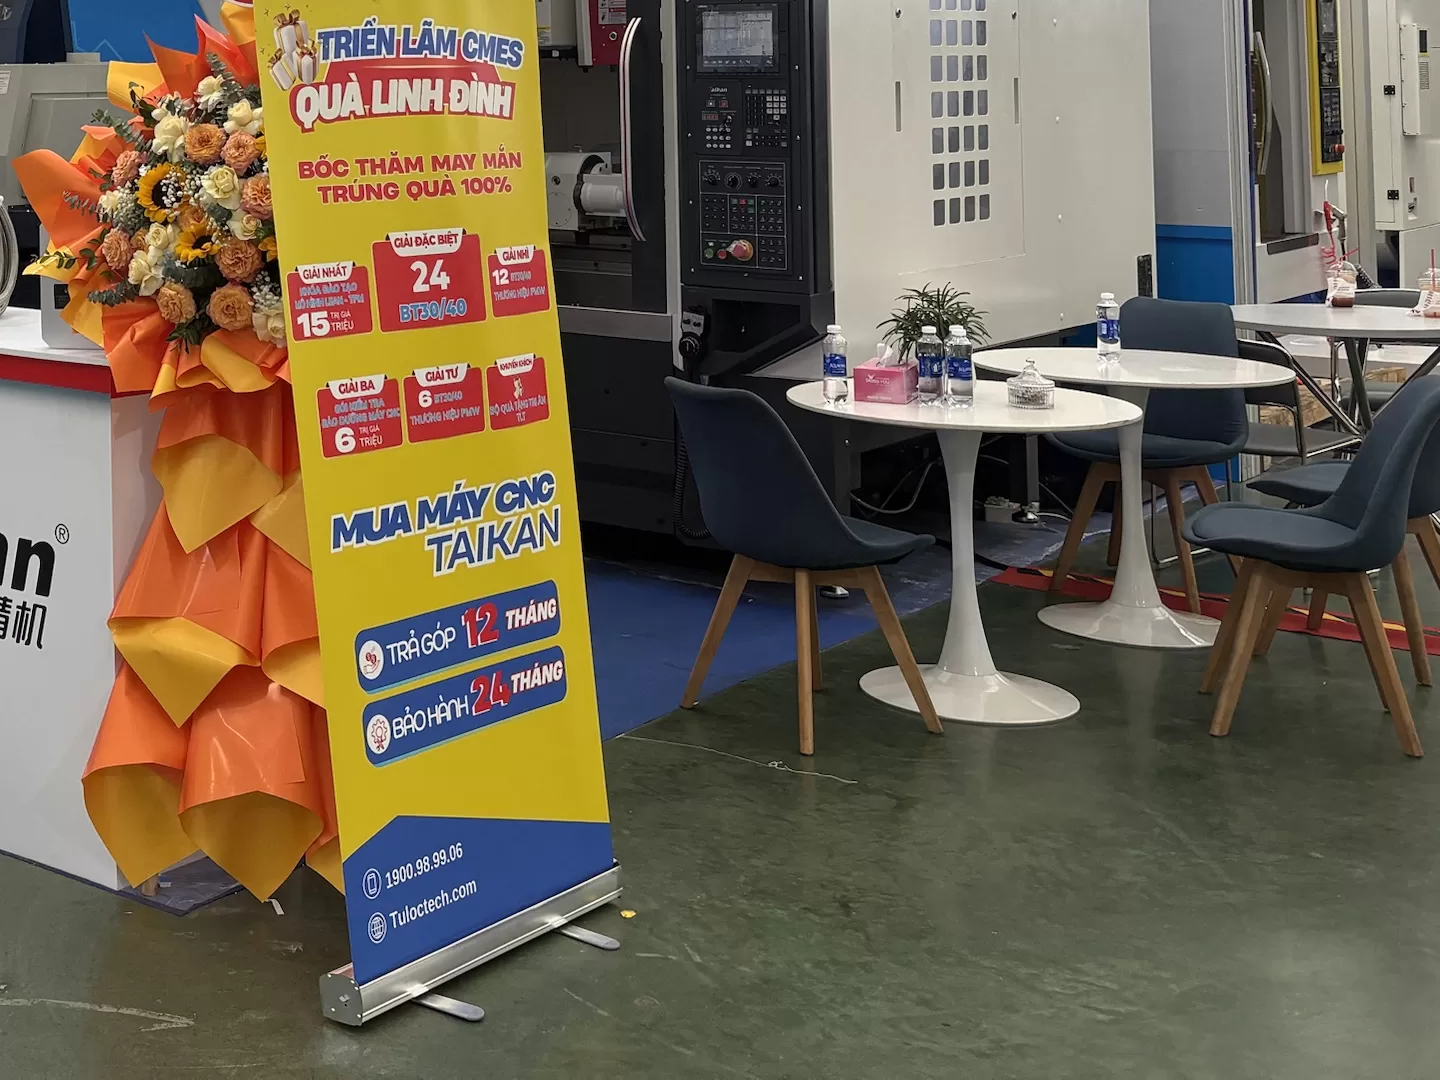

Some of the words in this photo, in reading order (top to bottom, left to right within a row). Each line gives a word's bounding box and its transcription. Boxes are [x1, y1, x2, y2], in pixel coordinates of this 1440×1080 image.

[318, 15, 395, 63] TRIỂN
[402, 18, 458, 59] LÃM
[461, 33, 524, 68] CMES
[294, 73, 368, 129] QUÀ
[373, 78, 445, 117] LINH
[448, 74, 514, 119] ĐÌNH
[298, 152, 349, 179] BỐC
[355, 150, 424, 176] THĂM
[432, 153, 475, 172] MAY
[483, 142, 522, 169] MẮN
[317, 178, 399, 204] TRÚNG
[406, 173, 454, 202] QUÀ
[461, 175, 512, 196] 100%
[394, 234, 413, 248] GIẢI
[415, 232, 436, 248] ĐẶC
[438, 232, 459, 246] BIỆT
[502, 248, 515, 261] GIẢI
[516, 247, 529, 259] NHÌ
[303, 268, 321, 280] GIẢI
[322, 265, 348, 278] NHẤT
[410, 259, 450, 293] 24
[492, 268, 509, 286] 12
[297, 310, 330, 337] 15
[330, 311, 340, 320] TRỊ
[341, 310, 351, 319] GIÁ
[399, 298, 467, 323] BT30/40
[331, 321, 354, 332] TRIỆU
[338, 379, 358, 394] GIẢI
[361, 380, 375, 392] BA
[425, 368, 445, 383] GIẢI
[446, 366, 460, 379] TƯ
[418, 390, 433, 408] 6
[335, 427, 356, 453] 6
[359, 436, 383, 447] TRIỆU
[332, 504, 412, 550] MUA
[417, 481, 490, 531] MÁY
[495, 472, 556, 514] CNC
[426, 507, 560, 574] TAIKAN
[386, 627, 422, 664] TRẢ
[421, 621, 456, 656] GÓP
[461, 602, 500, 648] 12
[506, 598, 557, 630] THÁNG
[392, 704, 426, 739] BẢO
[427, 692, 469, 727] HÀNH
[470, 670, 511, 716] 24
[511, 660, 564, 696] THÁNG
[385, 842, 463, 890] 1900.98.99.06
[389, 878, 477, 930] Tuloctech.com
